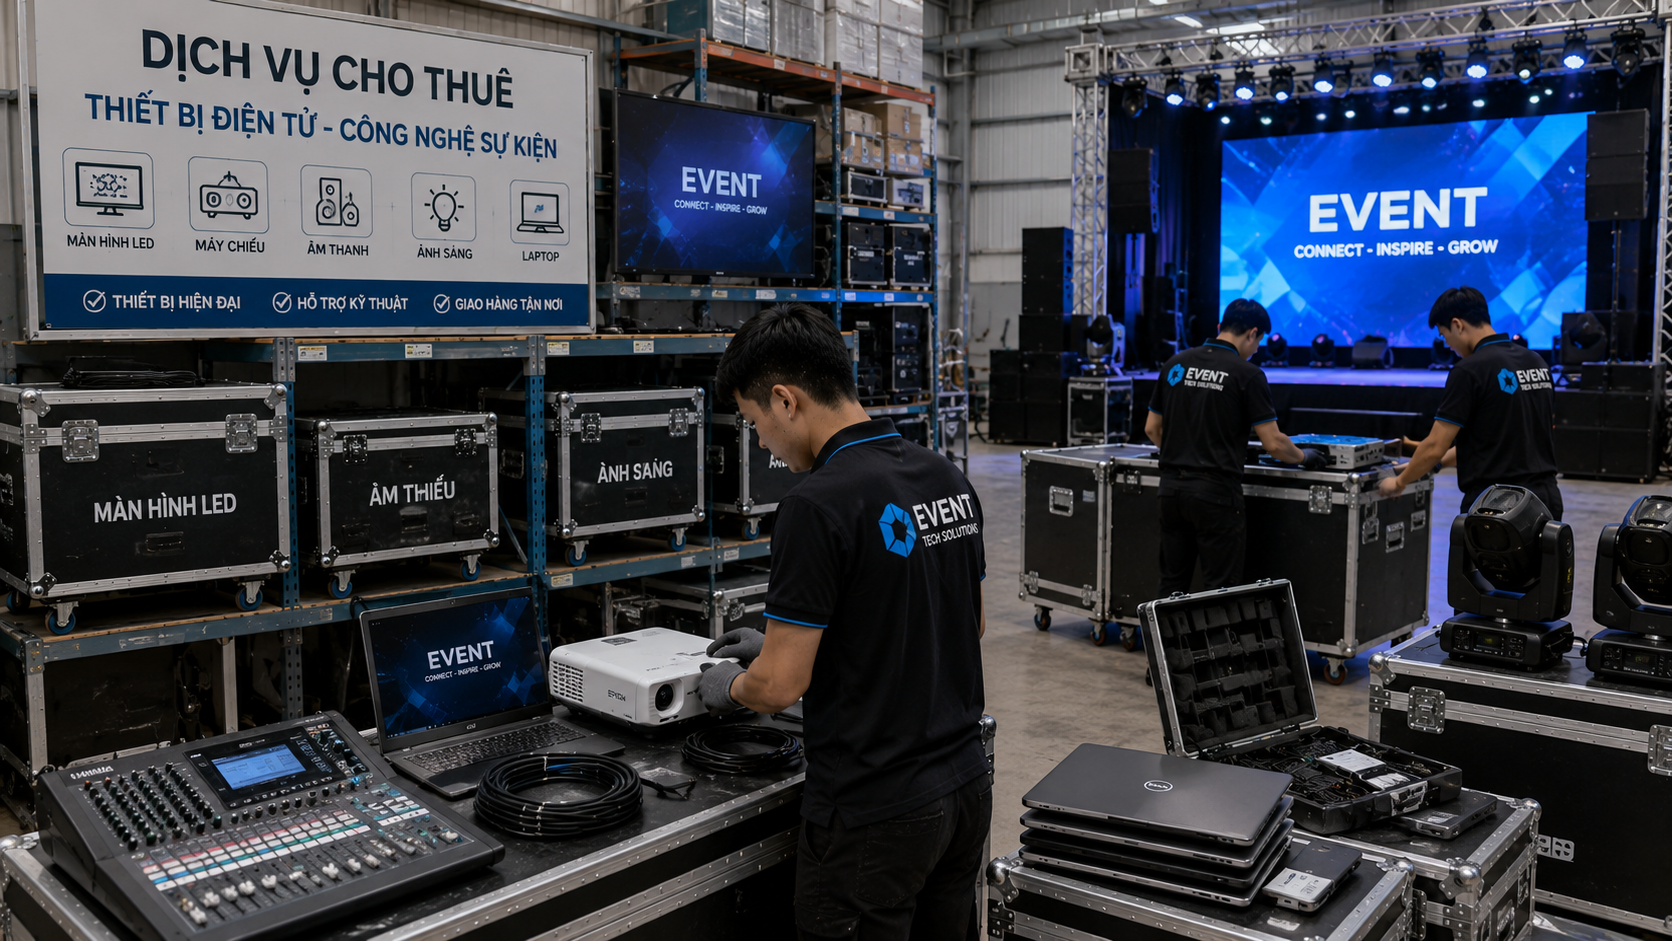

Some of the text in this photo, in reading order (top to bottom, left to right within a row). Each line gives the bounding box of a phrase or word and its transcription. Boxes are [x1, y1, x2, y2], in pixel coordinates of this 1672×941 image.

[142, 29, 514, 109] DỊCH VỤ CHO THUÊ
[84, 89, 170, 126] THIẾT
[178, 102, 203, 135] BỊ
[211, 102, 275, 139] ĐIỆN
[281, 106, 318, 138] TỬ
[339, 114, 409, 146] CÔNG
[415, 125, 476, 157] NGHỆ
[480, 132, 510, 159] SỰ
[514, 132, 558, 163] KIỆN
[682, 166, 762, 198] EVENT
[674, 199, 710, 210] CONNECT
[715, 202, 741, 213] INSPIRE
[746, 205, 768, 215] GROW
[1309, 187, 1488, 233] EVENT
[132, 237, 155, 249] LED
[328, 243, 369, 256] THANH
[1293, 243, 1365, 259] CONNECT
[1376, 241, 1434, 256] INSPIRE
[1447, 239, 1499, 255] GROW
[522, 250, 560, 262] LAPTOP
[112, 290, 241, 313] THIẾT BỊ HIỆN ĐẠI
[319, 295, 347, 313] TRỢ
[455, 294, 563, 314] GIAO HÀNG TẬN NƠI
[1185, 367, 1229, 384] EVENT
[1516, 368, 1550, 383] EVENT
[94, 491, 237, 523] MÀN HÌNH LED
[912, 494, 973, 530] EVENT
[922, 523, 978, 547] TECH SOLUTIONS
[427, 640, 494, 670] EVENT
[424, 670, 453, 682] CONNECT
